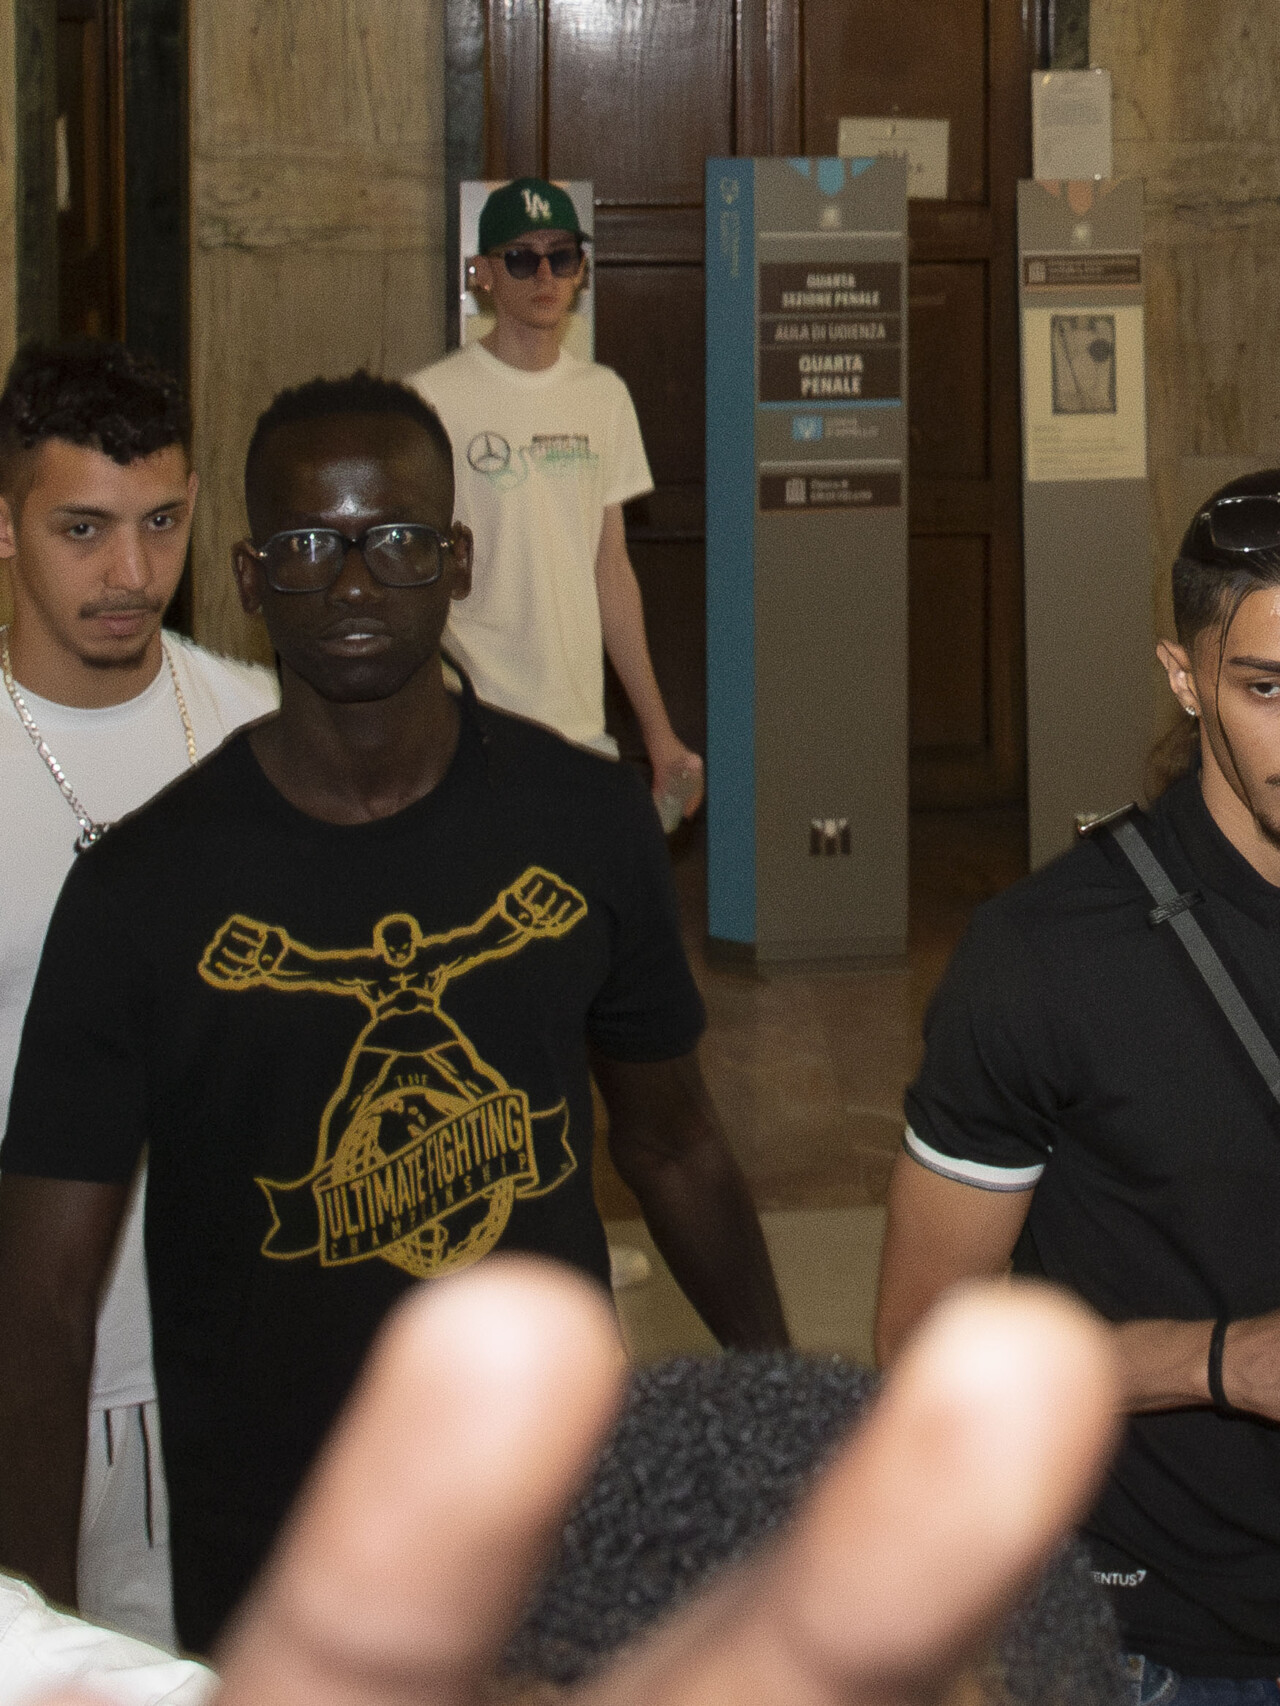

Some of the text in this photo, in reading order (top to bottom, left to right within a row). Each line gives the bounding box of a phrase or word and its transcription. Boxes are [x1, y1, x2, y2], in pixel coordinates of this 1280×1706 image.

[834, 290, 879, 307] PENALE
[799, 354, 863, 372] QUARTA
[802, 375, 861, 395] PENALE
